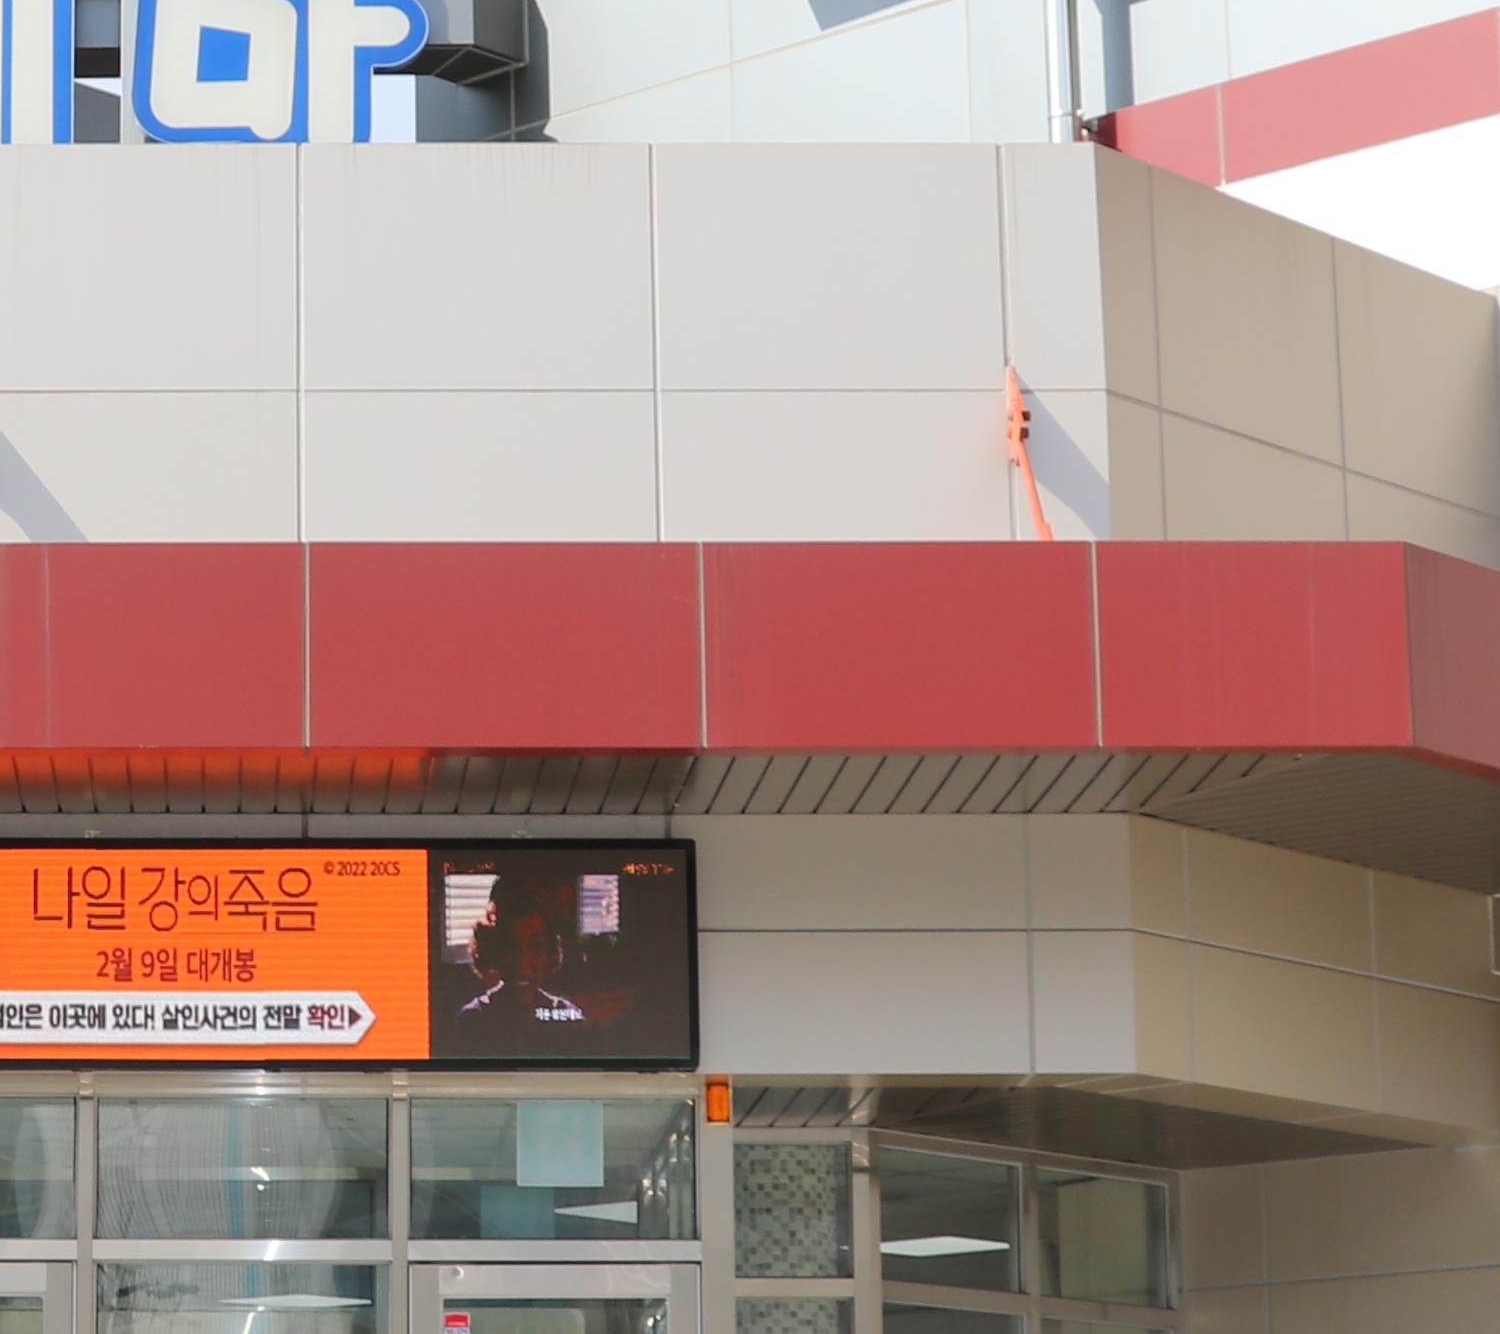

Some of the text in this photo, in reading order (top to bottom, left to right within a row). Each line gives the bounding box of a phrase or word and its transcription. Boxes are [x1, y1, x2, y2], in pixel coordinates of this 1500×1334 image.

[337, 861, 368, 876] 2022
[33, 866, 127, 929] 나일
[96, 948, 257, 983] 2월 9일 대개봉
[49, 1003, 107, 1030] 이곳에
[112, 1003, 156, 1030] 있다!
[162, 1004, 257, 1031] 살인사건의
[263, 1004, 302, 1031] 전말
[307, 1004, 346, 1031] 확인
